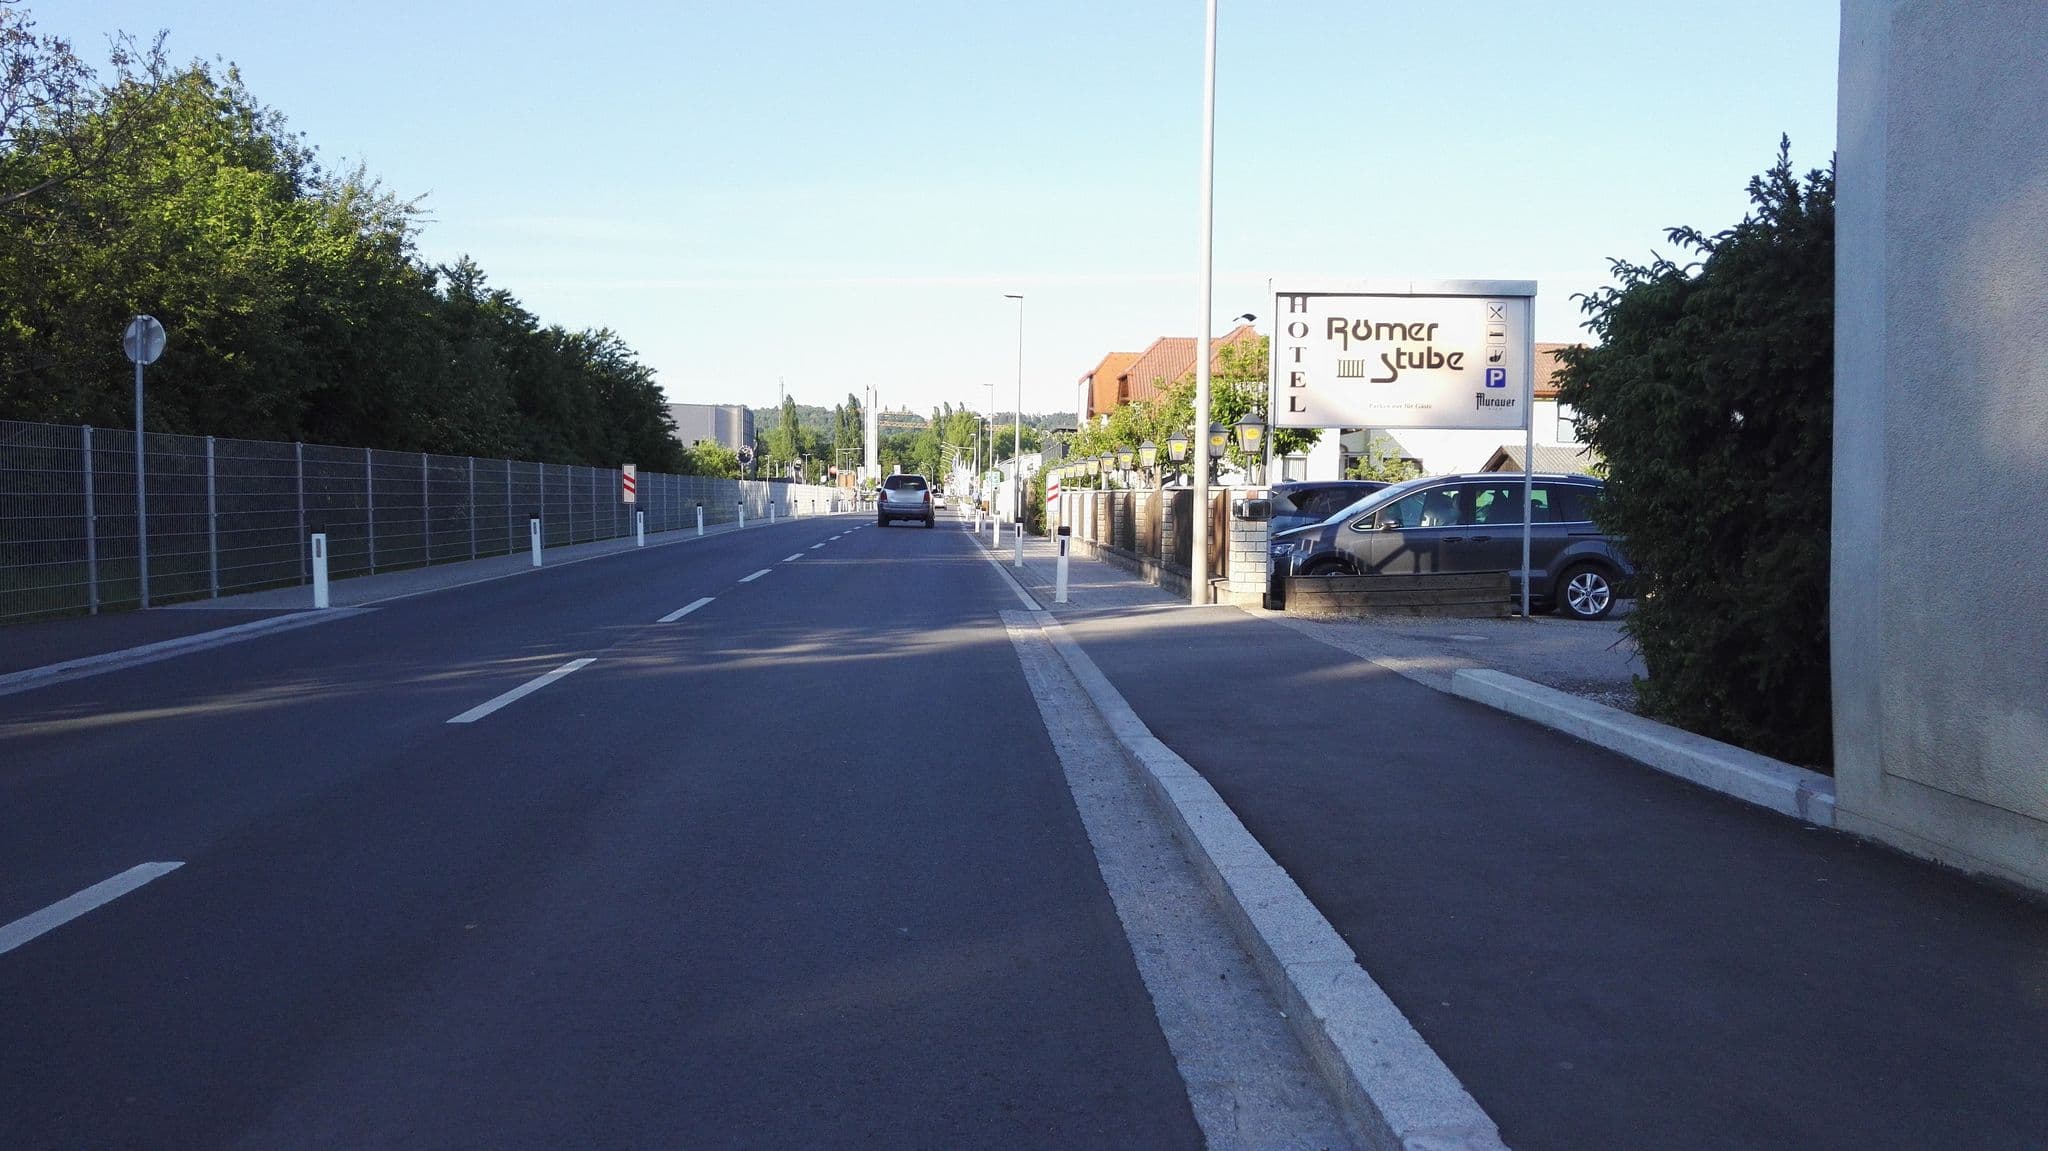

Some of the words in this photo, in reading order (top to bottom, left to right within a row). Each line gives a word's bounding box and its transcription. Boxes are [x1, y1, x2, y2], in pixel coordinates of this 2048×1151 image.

[1327, 316, 1439, 351] Römer
[1287, 296, 1309, 413] HOTEL
[1370, 346, 1464, 383] Stube
[1475, 392, 1516, 410] Murauer
